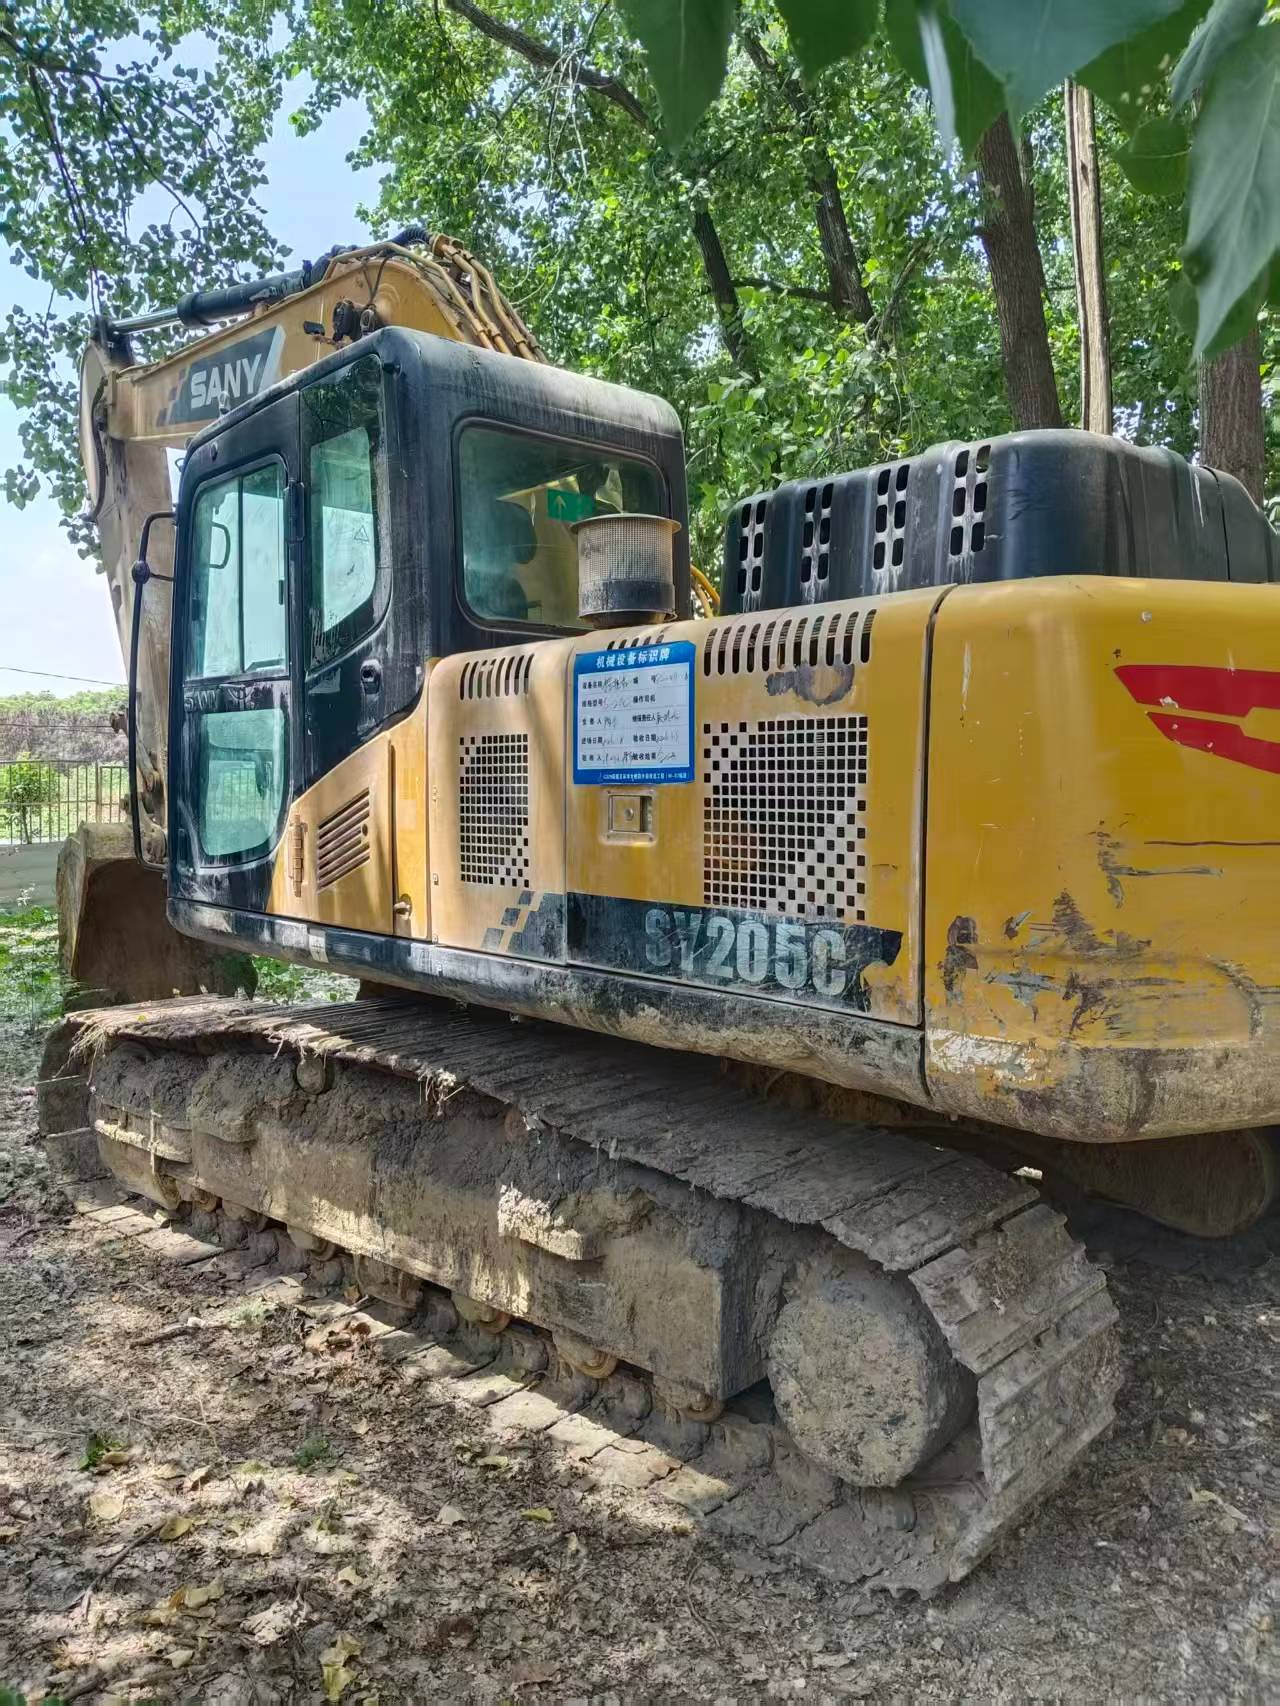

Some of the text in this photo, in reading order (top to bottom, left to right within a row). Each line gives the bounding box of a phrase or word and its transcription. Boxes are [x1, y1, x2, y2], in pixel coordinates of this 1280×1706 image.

[191, 353, 261, 408] SANY
[596, 647, 670, 668] 机械设备标识牌
[645, 908, 846, 996] SY205C
